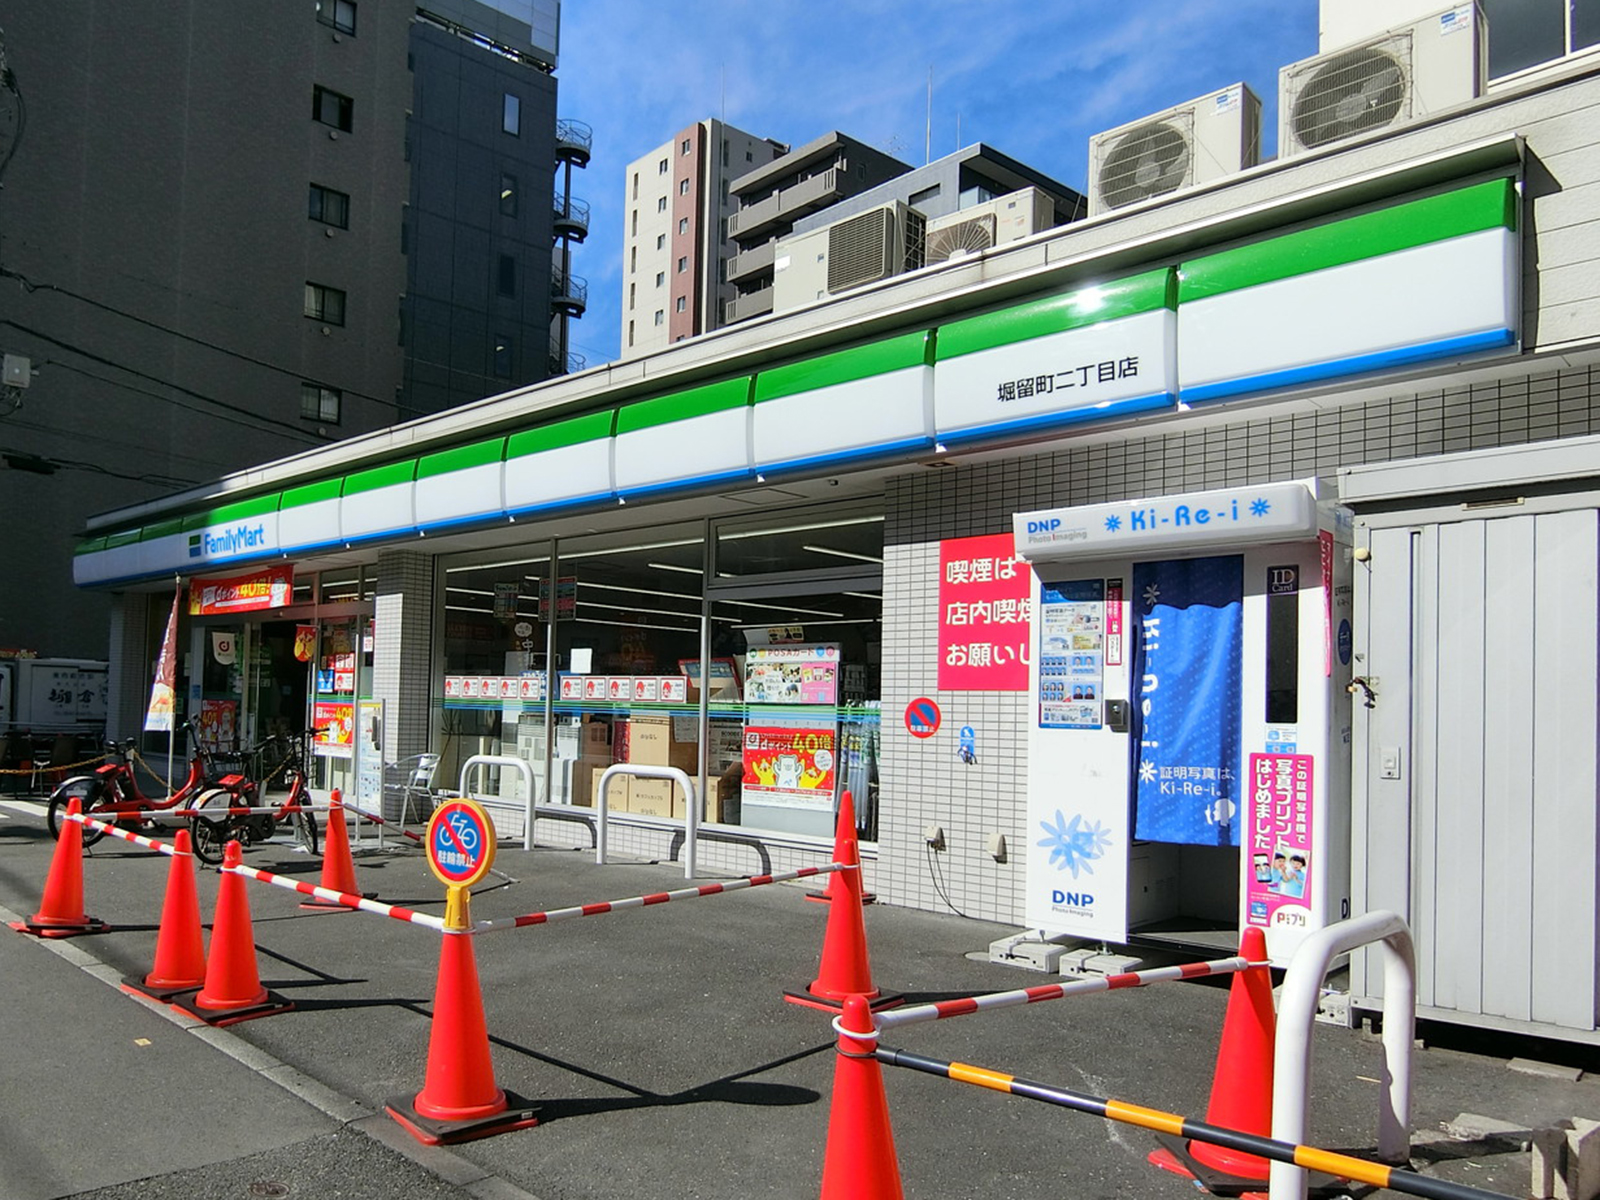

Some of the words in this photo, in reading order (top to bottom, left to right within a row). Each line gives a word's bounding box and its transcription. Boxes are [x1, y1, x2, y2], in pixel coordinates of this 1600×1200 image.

[997, 356, 1139, 402] 堀留町二丁目店
[1027, 518, 1061, 534] DNP
[1131, 500, 1239, 531] Ki-Re-i
[204, 524, 265, 555] FamilyMart
[1028, 534, 1051, 544] Photo
[1052, 530, 1088, 542] Imaging
[946, 556, 1017, 585] 喫煙は
[1272, 569, 1295, 585] ID
[1272, 583, 1293, 592] Card
[1254, 758, 1273, 849] はじめました
[1275, 758, 1293, 851] 写真プリント
[437, 850, 475, 868] 駐輪禁止
[1052, 889, 1094, 907] DNP
